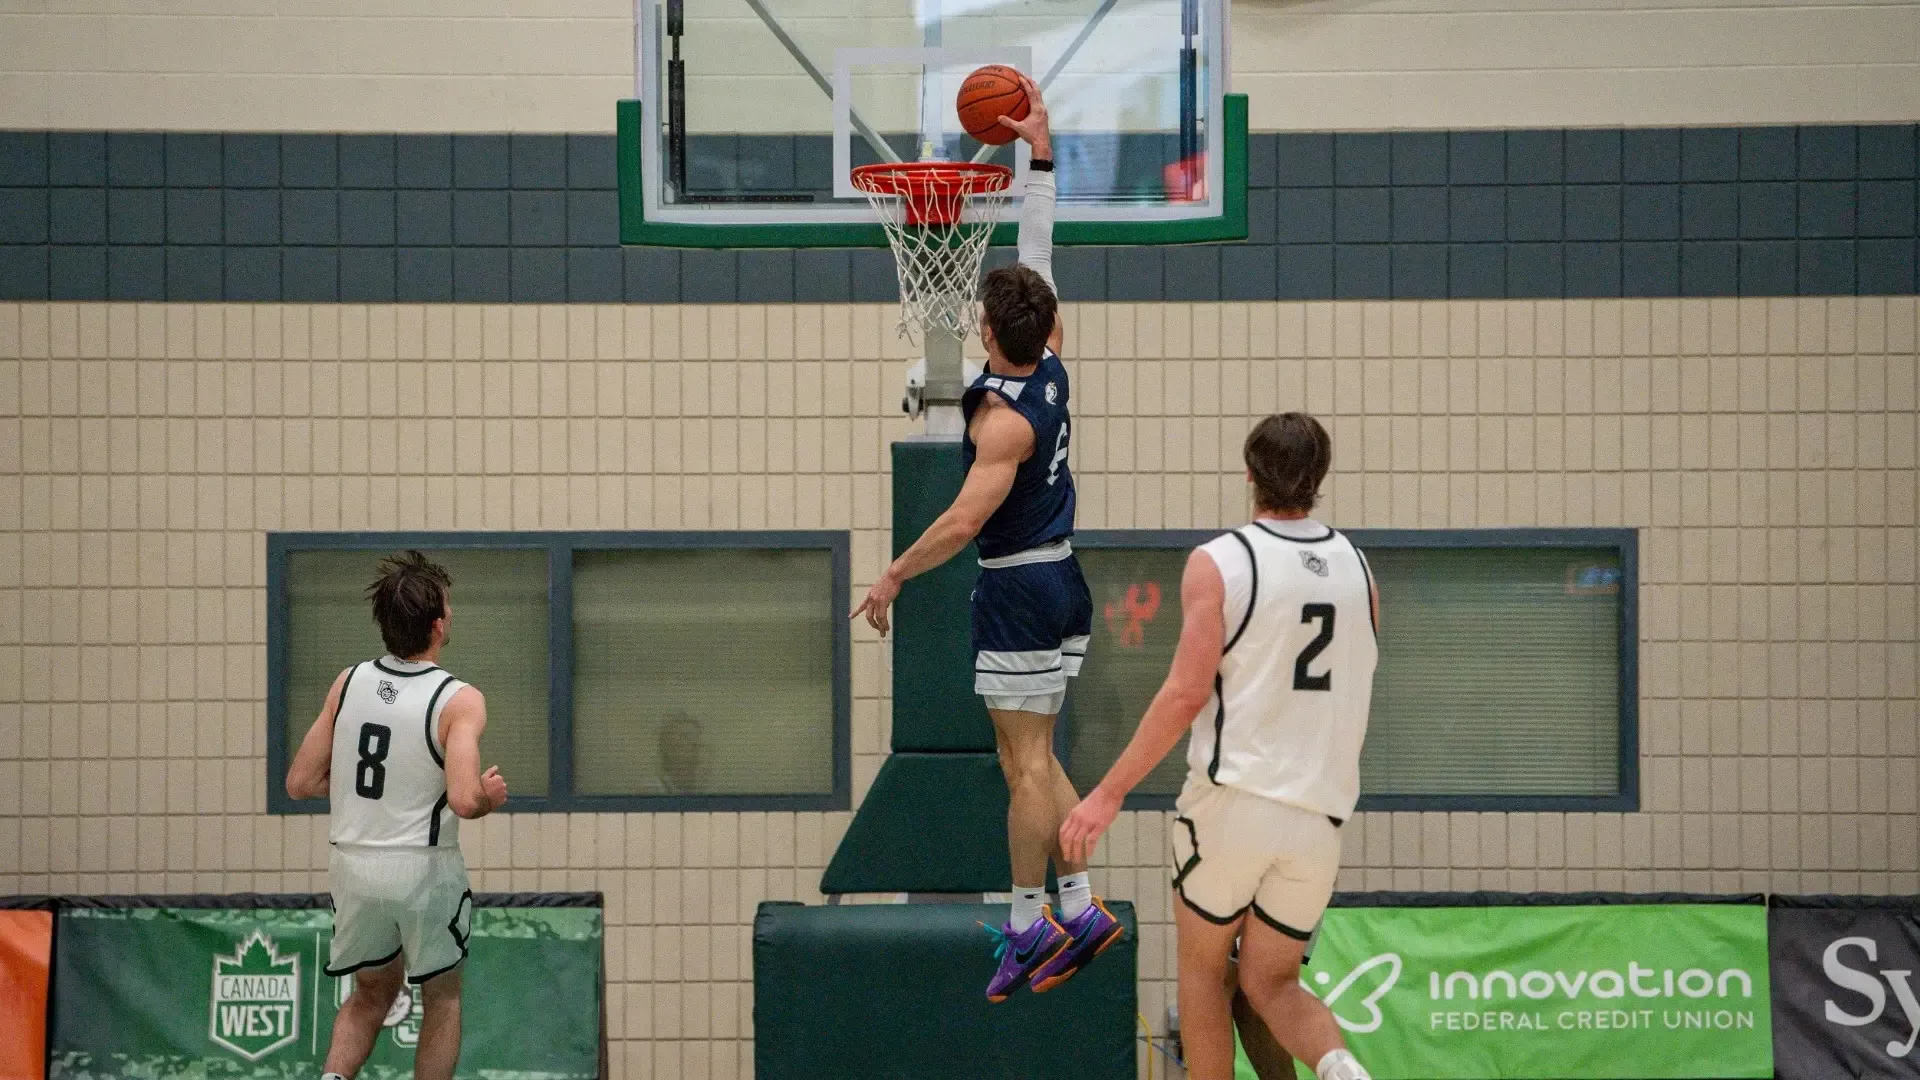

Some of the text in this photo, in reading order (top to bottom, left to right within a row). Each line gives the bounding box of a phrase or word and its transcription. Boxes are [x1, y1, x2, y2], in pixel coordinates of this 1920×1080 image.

[1293, 603, 1336, 691] 2
[356, 722, 391, 800] 8
[220, 977, 291, 999] CANADA
[1429, 960, 1752, 1000] innovation
[220, 1004, 291, 1037] WEST
[1430, 1009, 1754, 1031] FEDERAL CREDIT UNION
